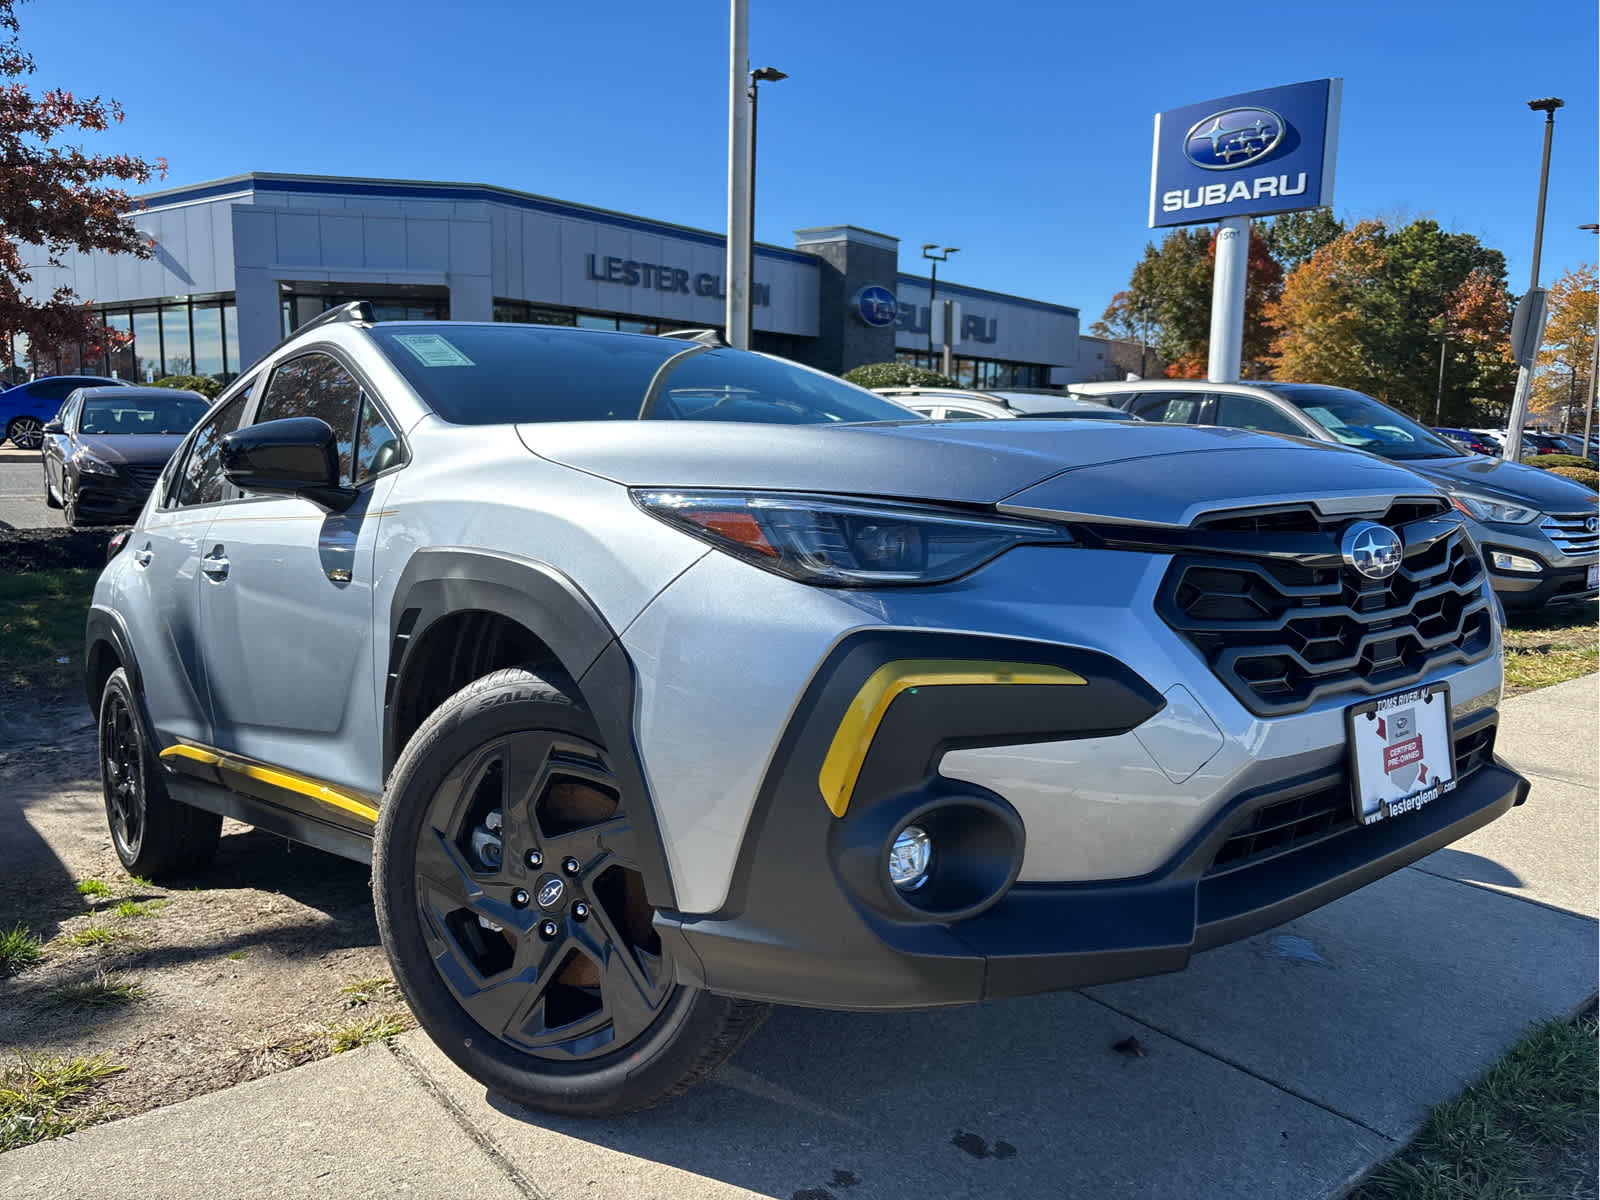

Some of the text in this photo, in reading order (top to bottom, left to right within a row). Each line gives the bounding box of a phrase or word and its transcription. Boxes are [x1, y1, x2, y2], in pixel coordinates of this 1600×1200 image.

[1161, 171, 1307, 213] SUBARU
[586, 252, 770, 308] LESTER GLN
[1376, 696, 1399, 711] TOMS
